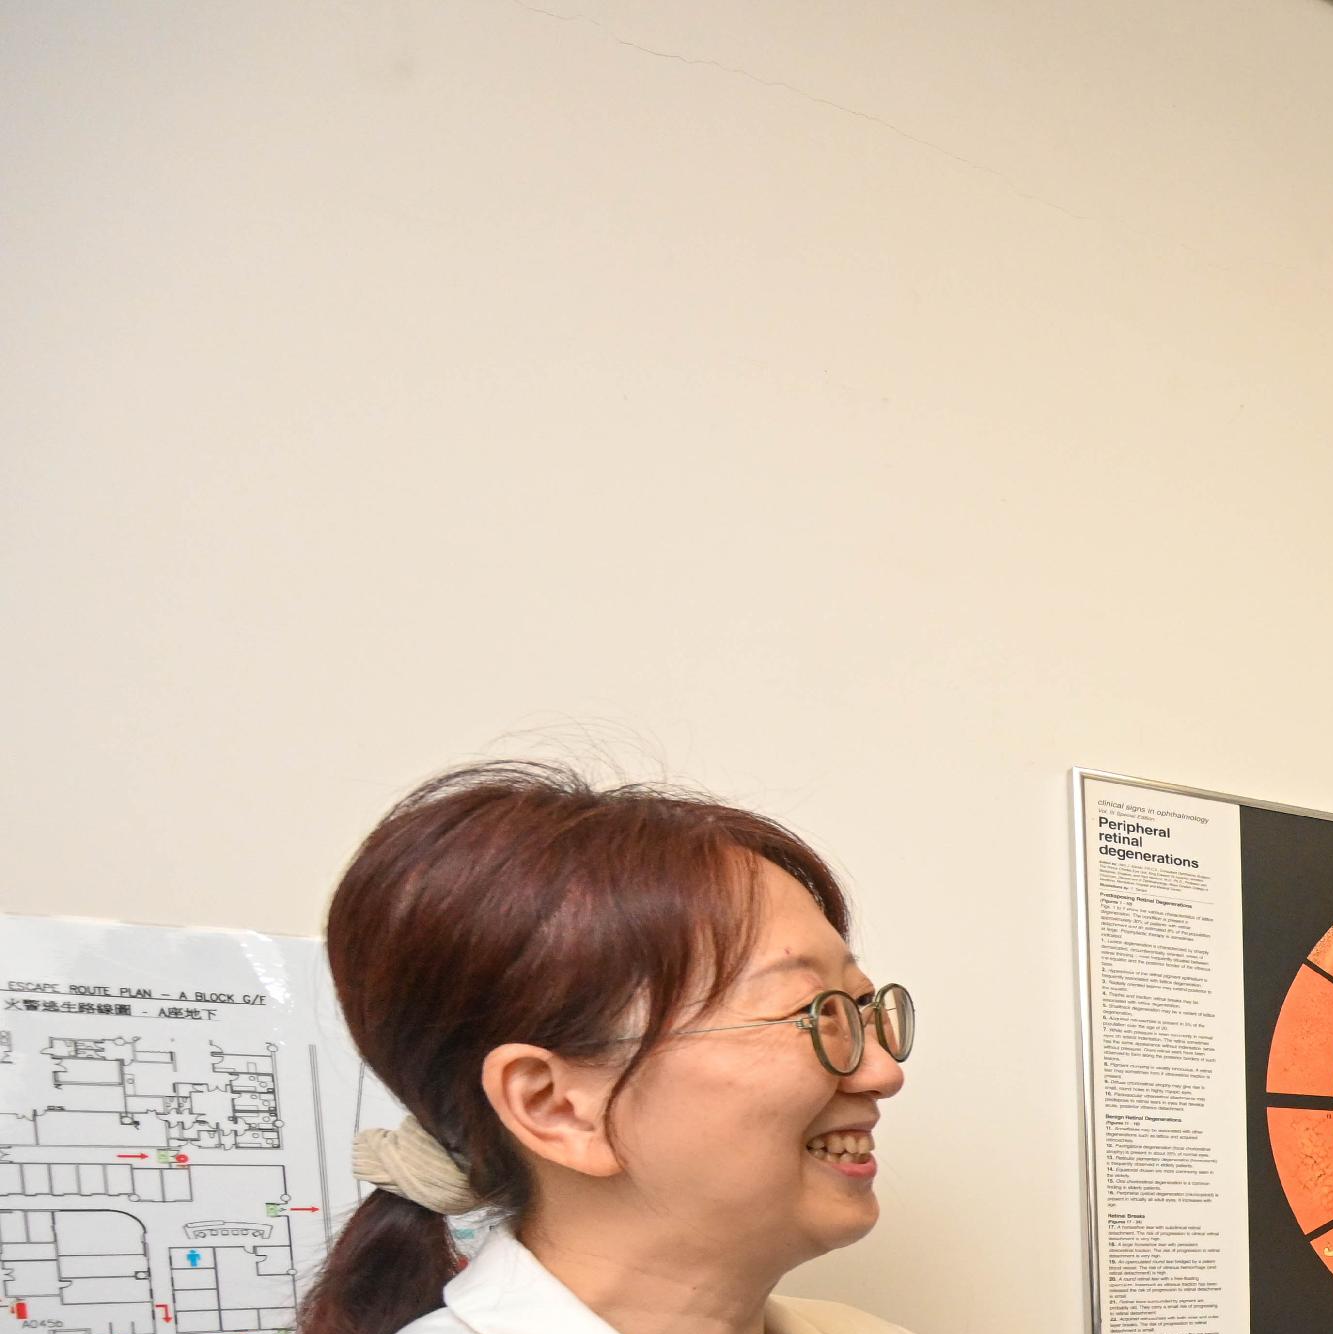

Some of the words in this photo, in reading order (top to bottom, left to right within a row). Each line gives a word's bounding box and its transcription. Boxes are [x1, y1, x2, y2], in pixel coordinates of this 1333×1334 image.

[1098, 800, 1124, 809] clinical
[1126, 803, 1146, 813] signs
[1156, 810, 1209, 824] ophthalmology
[1098, 816, 1171, 838] Peripheral
[1099, 832, 1143, 847] retinal
[1099, 844, 1199, 869] degenerations
[8, 980, 61, 993] ESCAPE
[69, 984, 111, 996] ROUTE
[120, 987, 152, 999] PLAN
[179, 991, 188, 1000] A
[194, 991, 235, 1004] BLOCK
[242, 994, 267, 1006] G/F
